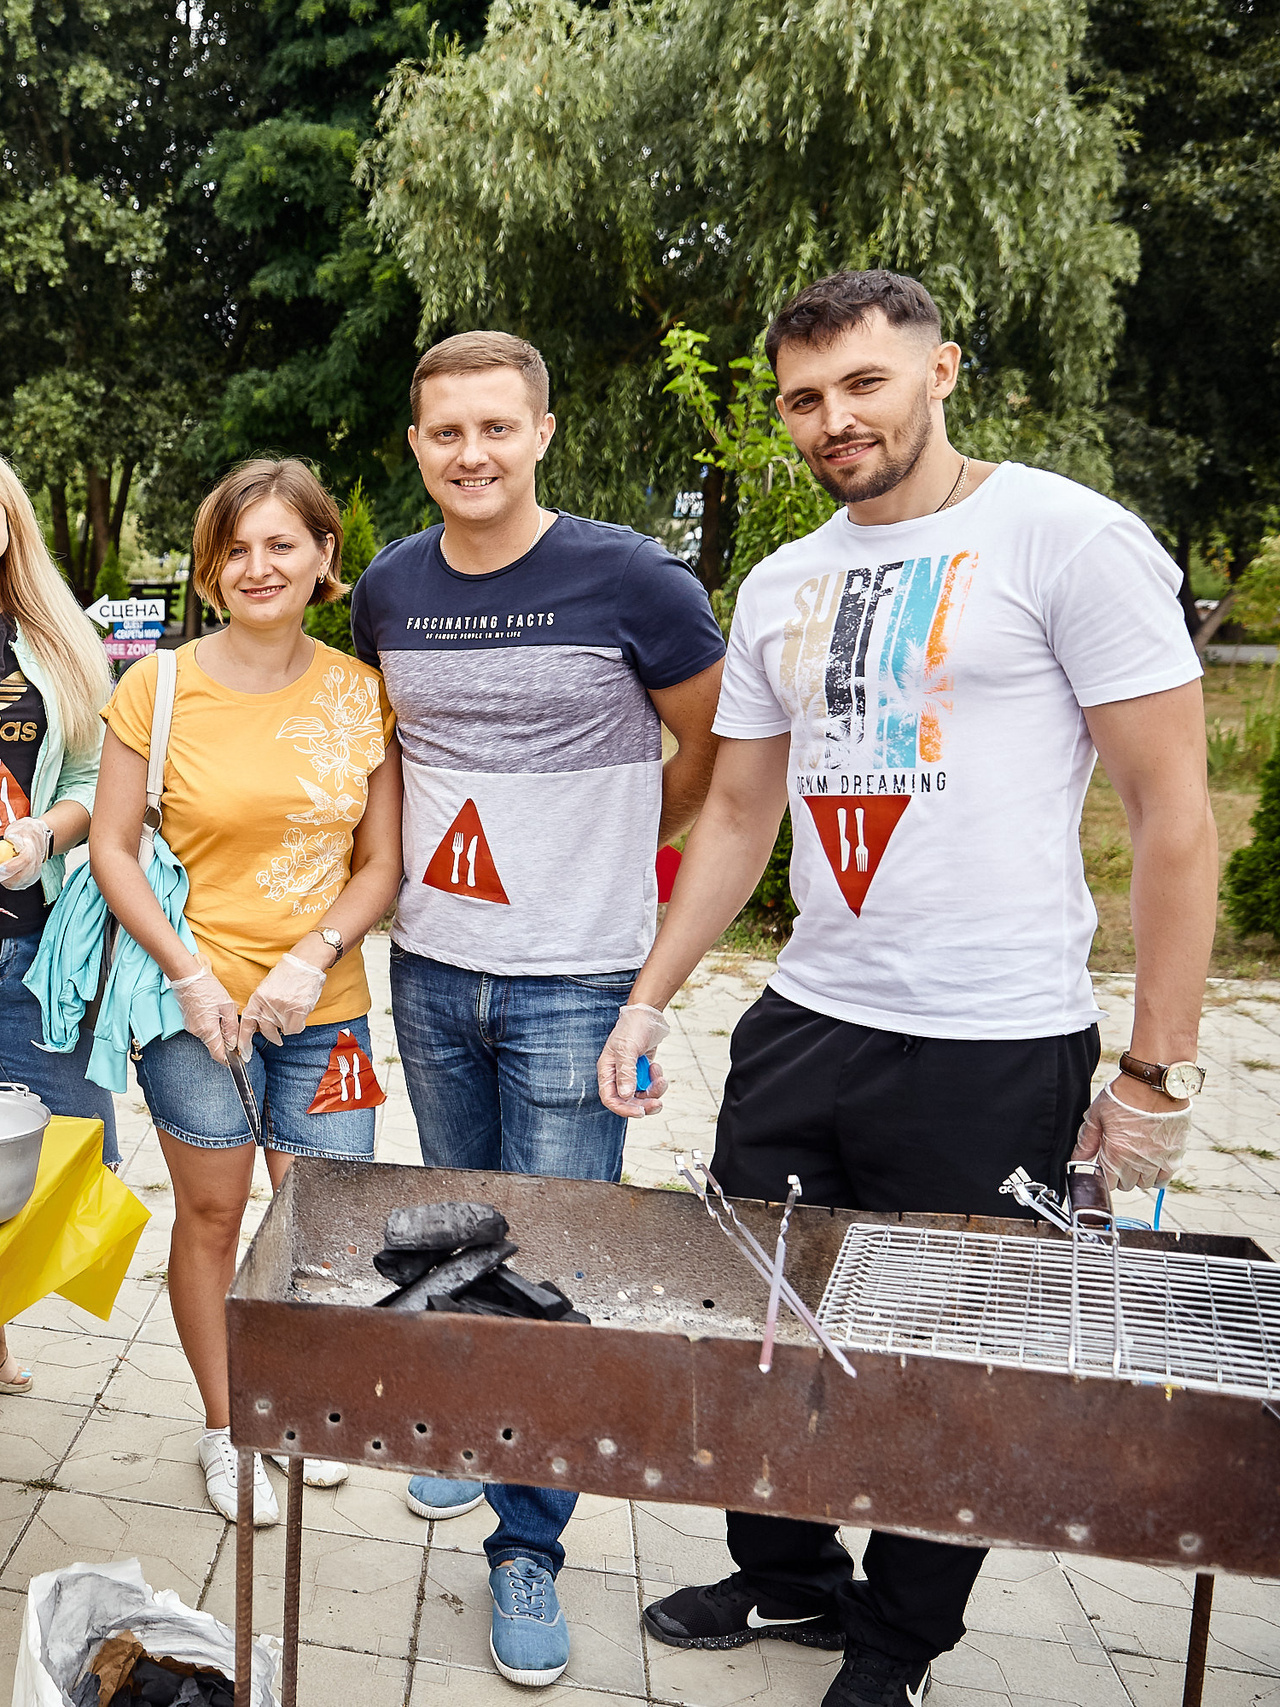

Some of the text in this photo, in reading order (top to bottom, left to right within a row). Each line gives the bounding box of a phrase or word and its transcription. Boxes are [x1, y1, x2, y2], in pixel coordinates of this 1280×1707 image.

[99, 604, 160, 618] СЦЕНА
[406, 612, 555, 630] FASCINATING FACTS
[105, 643, 125, 656] REE
[841, 771, 947, 794] DREAMING
[287, 900, 323, 917] Brave
